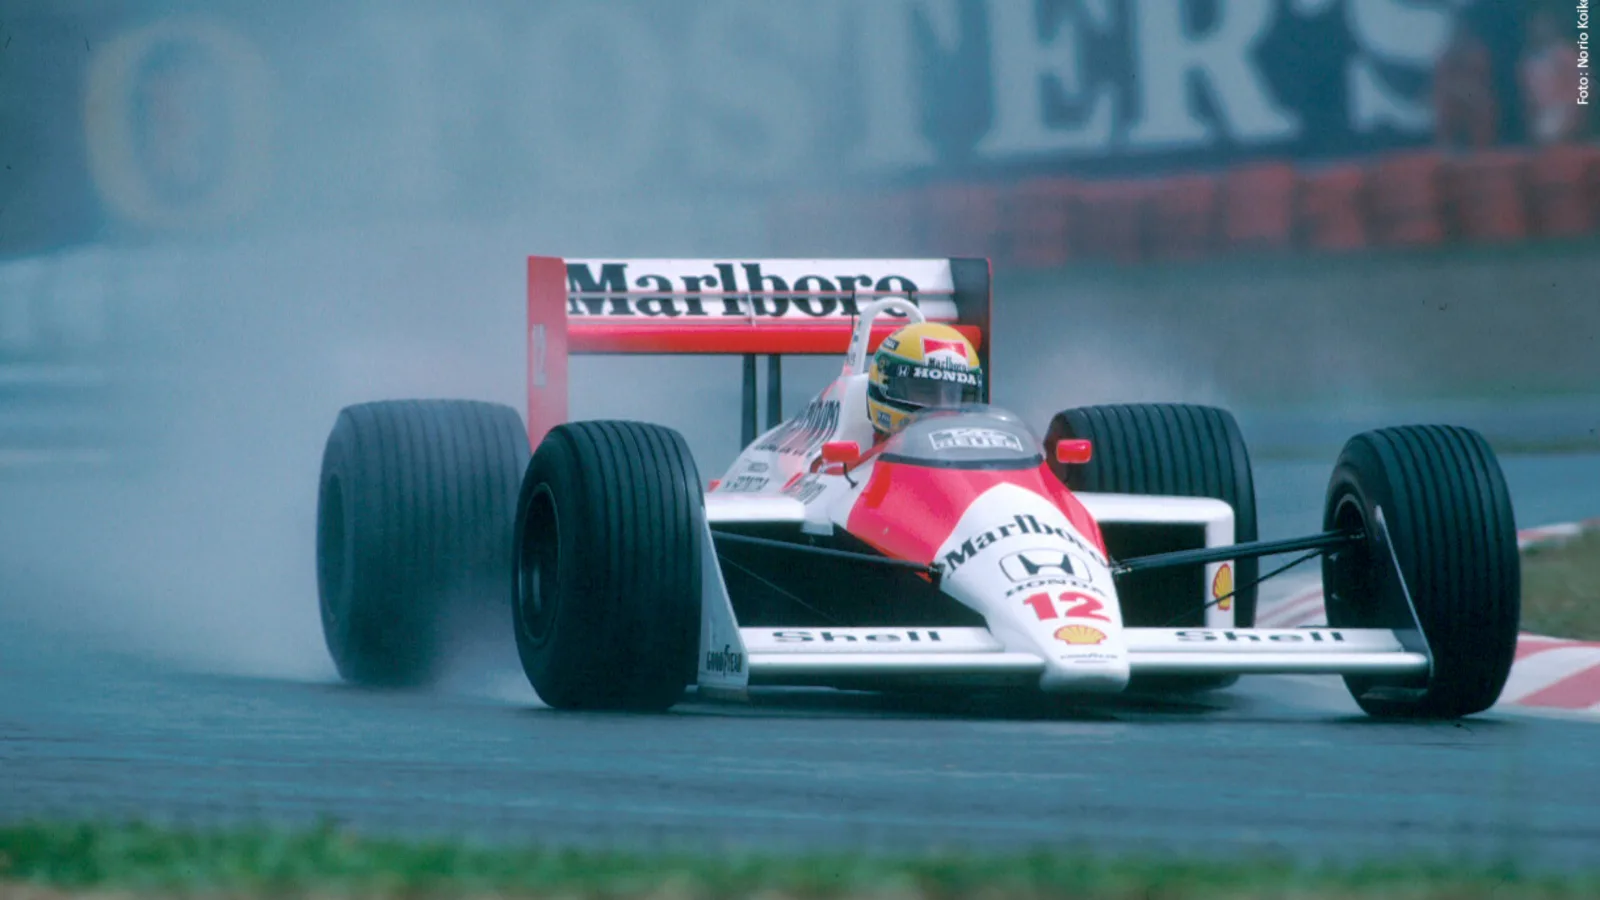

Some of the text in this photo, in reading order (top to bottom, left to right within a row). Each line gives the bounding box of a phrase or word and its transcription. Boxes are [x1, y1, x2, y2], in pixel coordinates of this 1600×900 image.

[566, 263, 919, 317] Marlboro
[913, 367, 977, 385] HONDA
[1023, 591, 1112, 622] 12
[772, 630, 942, 643] Shell
[1175, 630, 1345, 642] Shell
